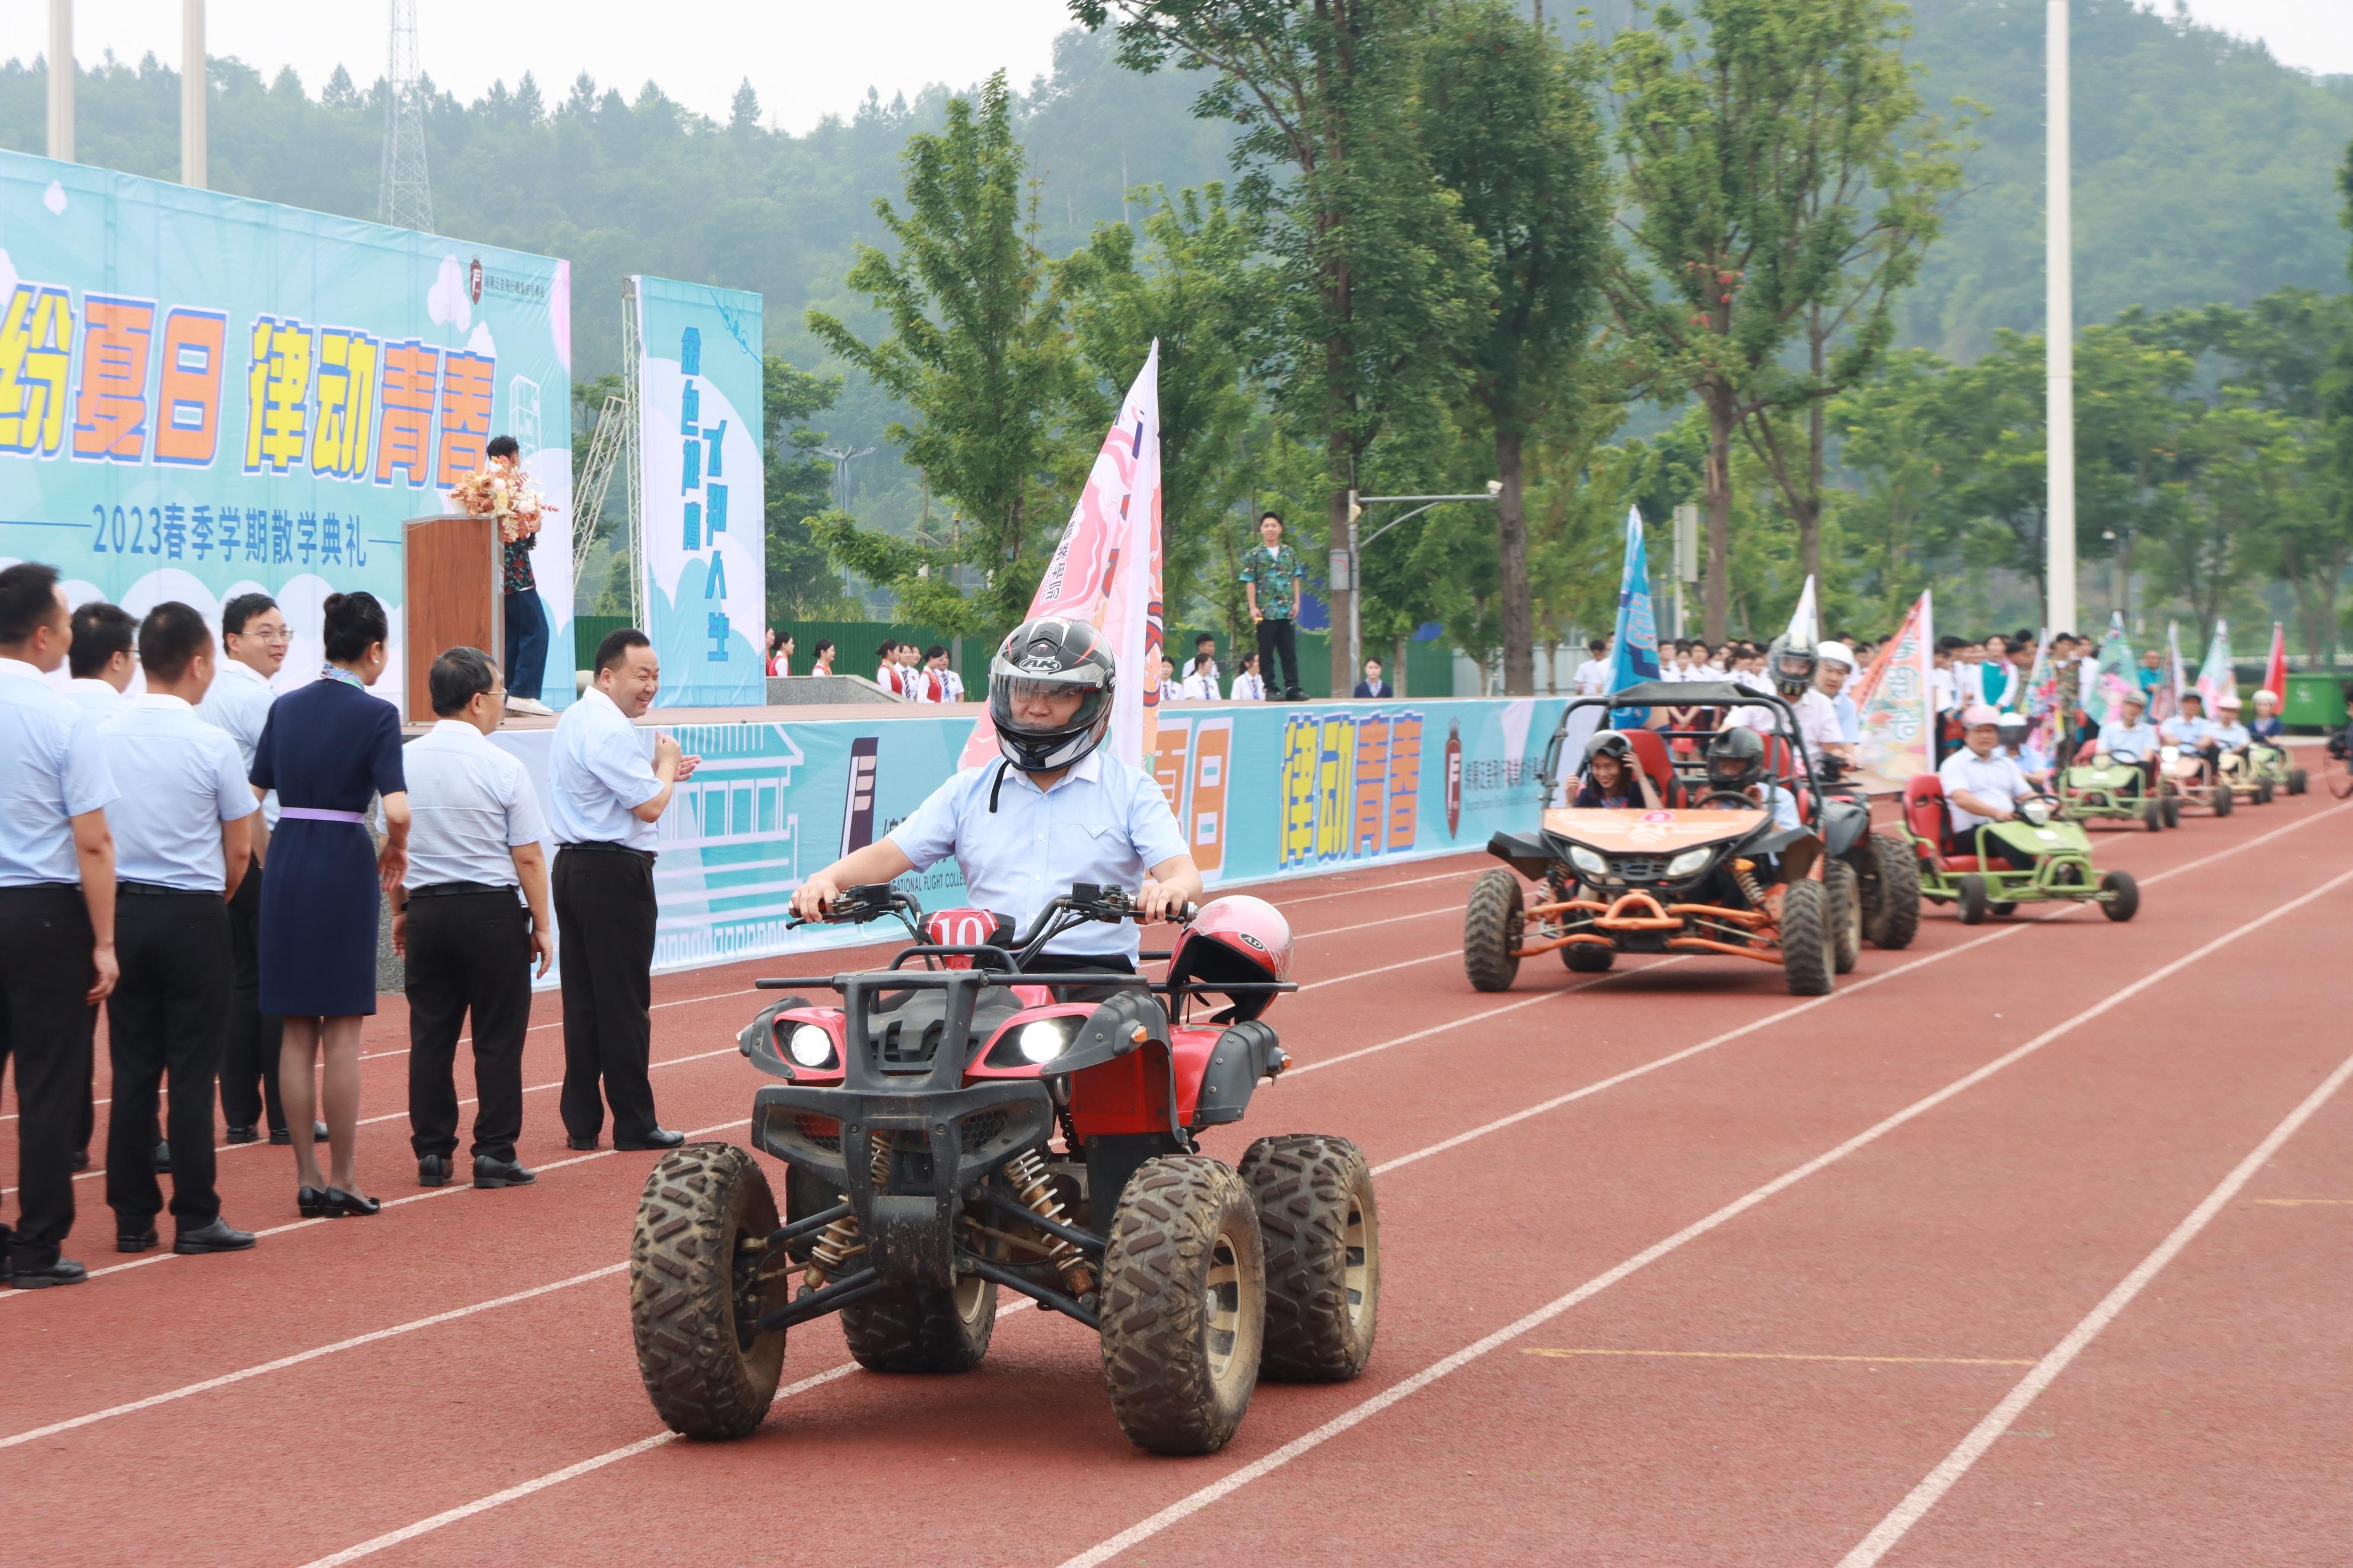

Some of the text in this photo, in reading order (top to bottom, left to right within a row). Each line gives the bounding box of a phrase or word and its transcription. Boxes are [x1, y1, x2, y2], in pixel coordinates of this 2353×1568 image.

[242, 313, 497, 491] 律动青春
[93, 502, 366, 568] 2023春季学期散学典礼
[703, 419, 729, 662] 飞翔人生
[1279, 710, 1424, 872] 律动青春
[924, 874, 943, 890] FLIGHT
[938, 917, 984, 957] 10
